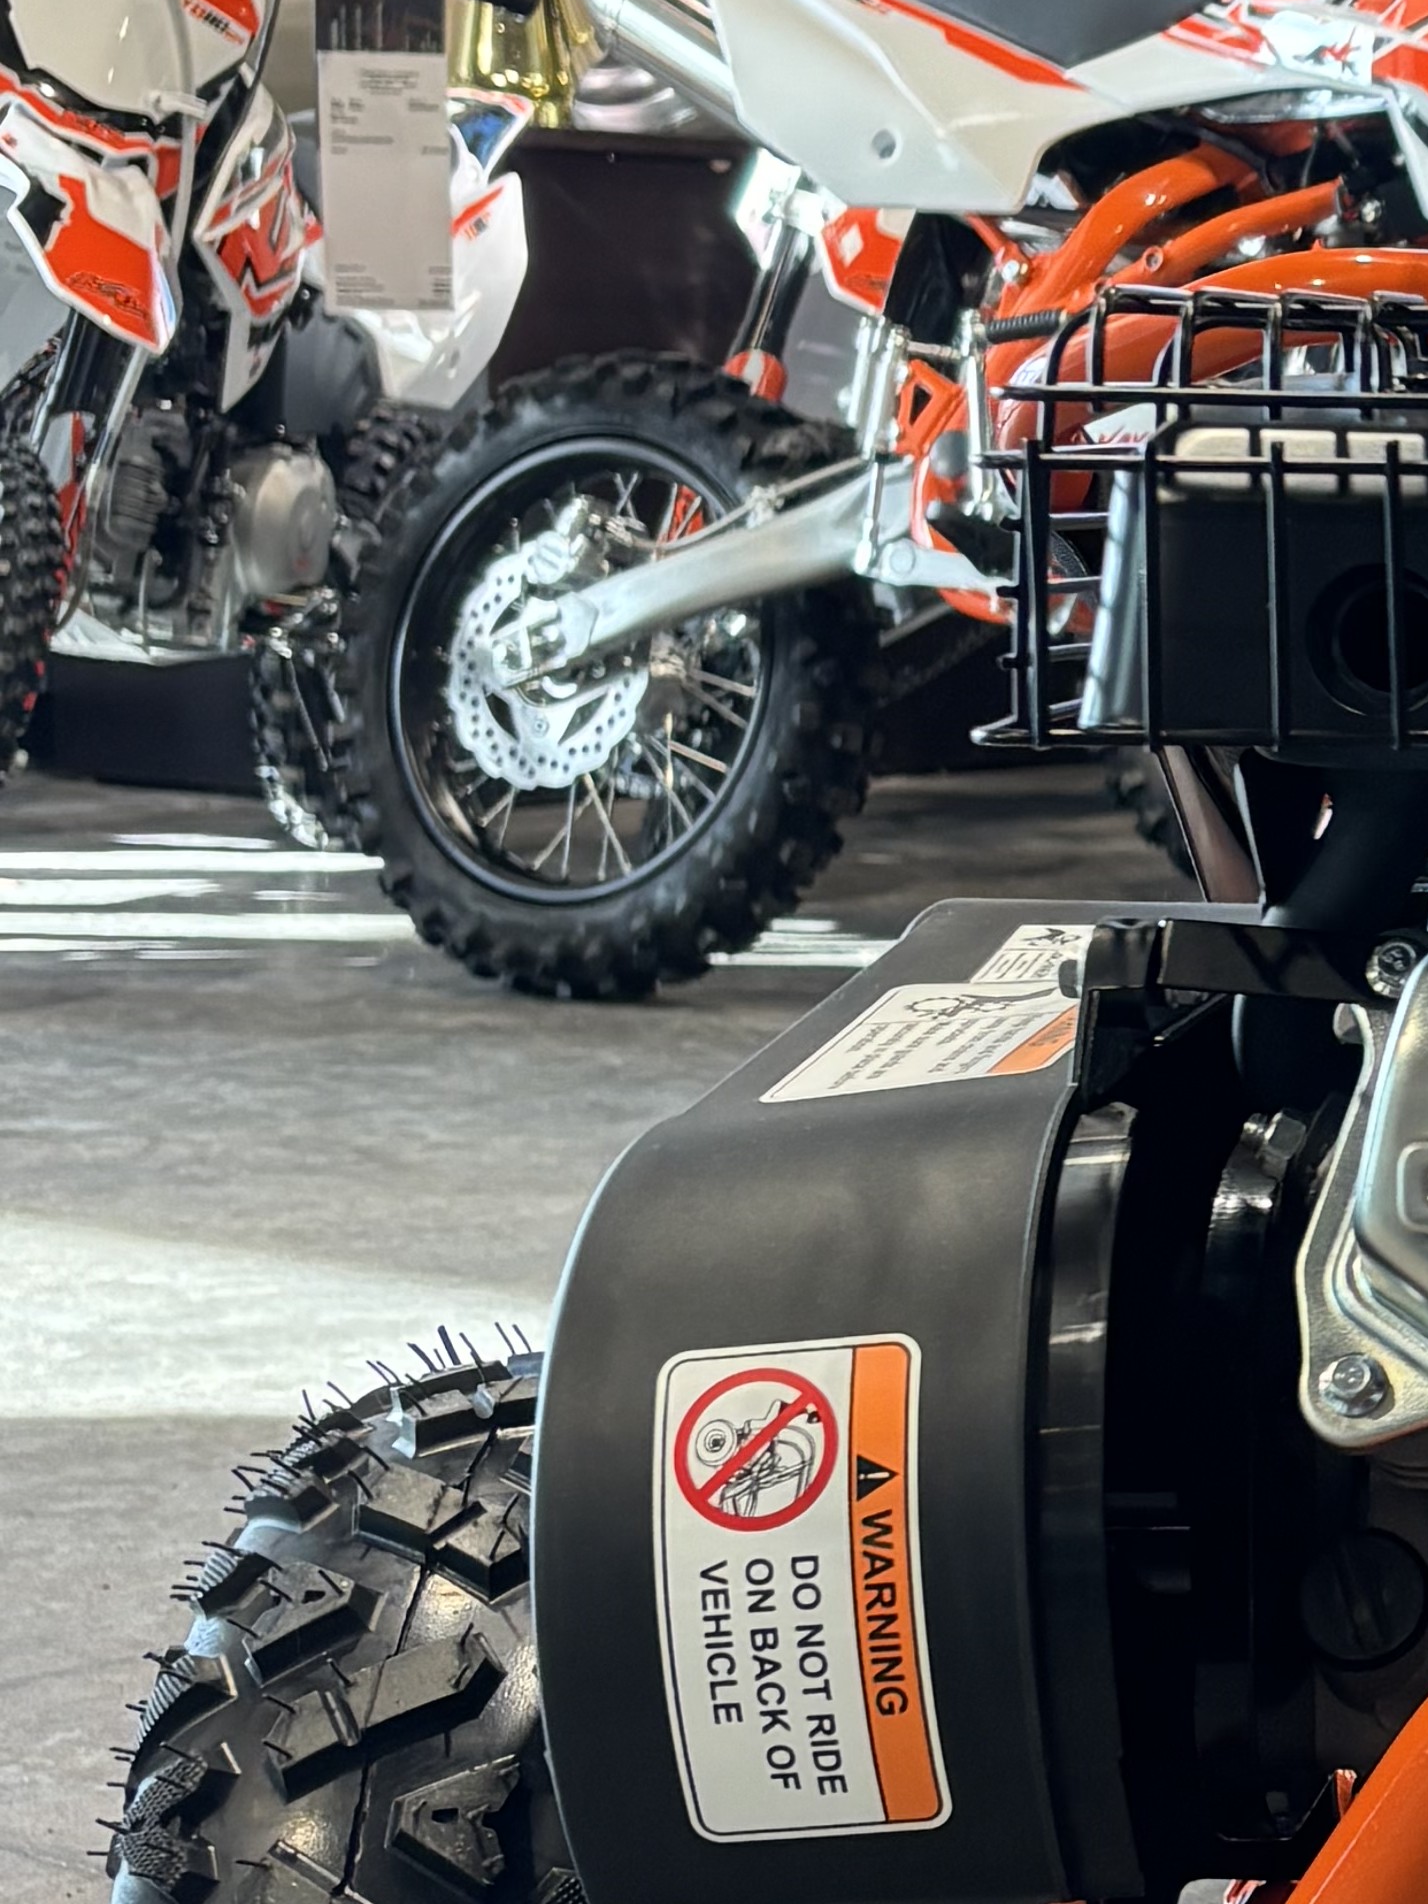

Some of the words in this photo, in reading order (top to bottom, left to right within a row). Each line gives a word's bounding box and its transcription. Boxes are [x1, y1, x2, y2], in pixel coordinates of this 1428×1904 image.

[744, 1557, 777, 1614] ON
[790, 1554, 821, 1611] DO
[860, 1508, 909, 1717] WARNING
[699, 1559, 744, 1726] VEHICLE
[749, 1627, 791, 1735] BACK
[794, 1623, 833, 1702] NOT
[766, 1744, 802, 1792] OF
[806, 1713, 849, 1797] RIDE
